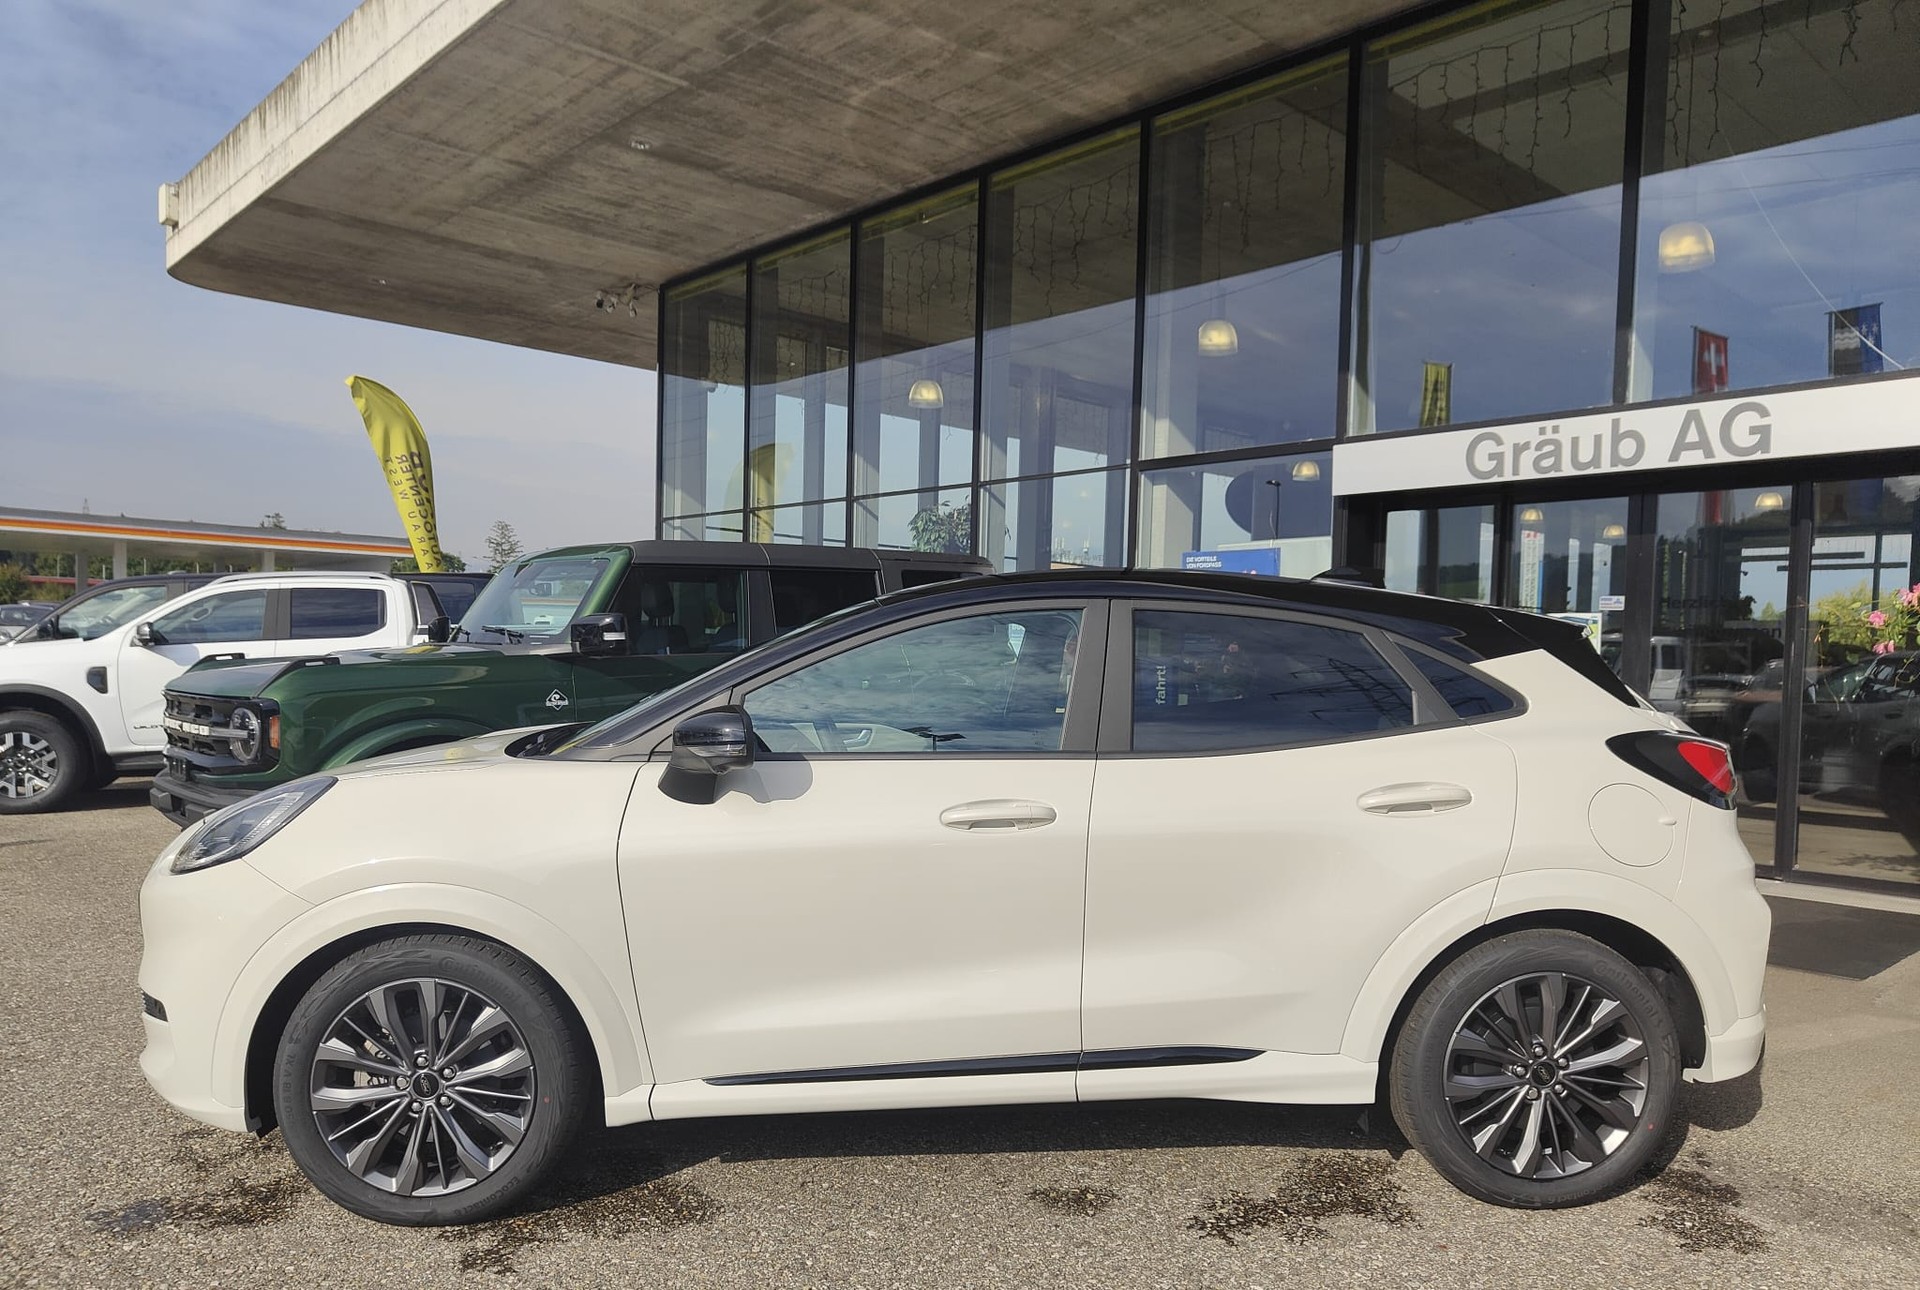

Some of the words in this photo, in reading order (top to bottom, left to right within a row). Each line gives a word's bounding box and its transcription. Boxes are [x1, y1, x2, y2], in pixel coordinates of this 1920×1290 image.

[1466, 418, 1645, 480] Gräub
[1668, 401, 1772, 463] AG
[1155, 665, 1166, 704] fahrt!
